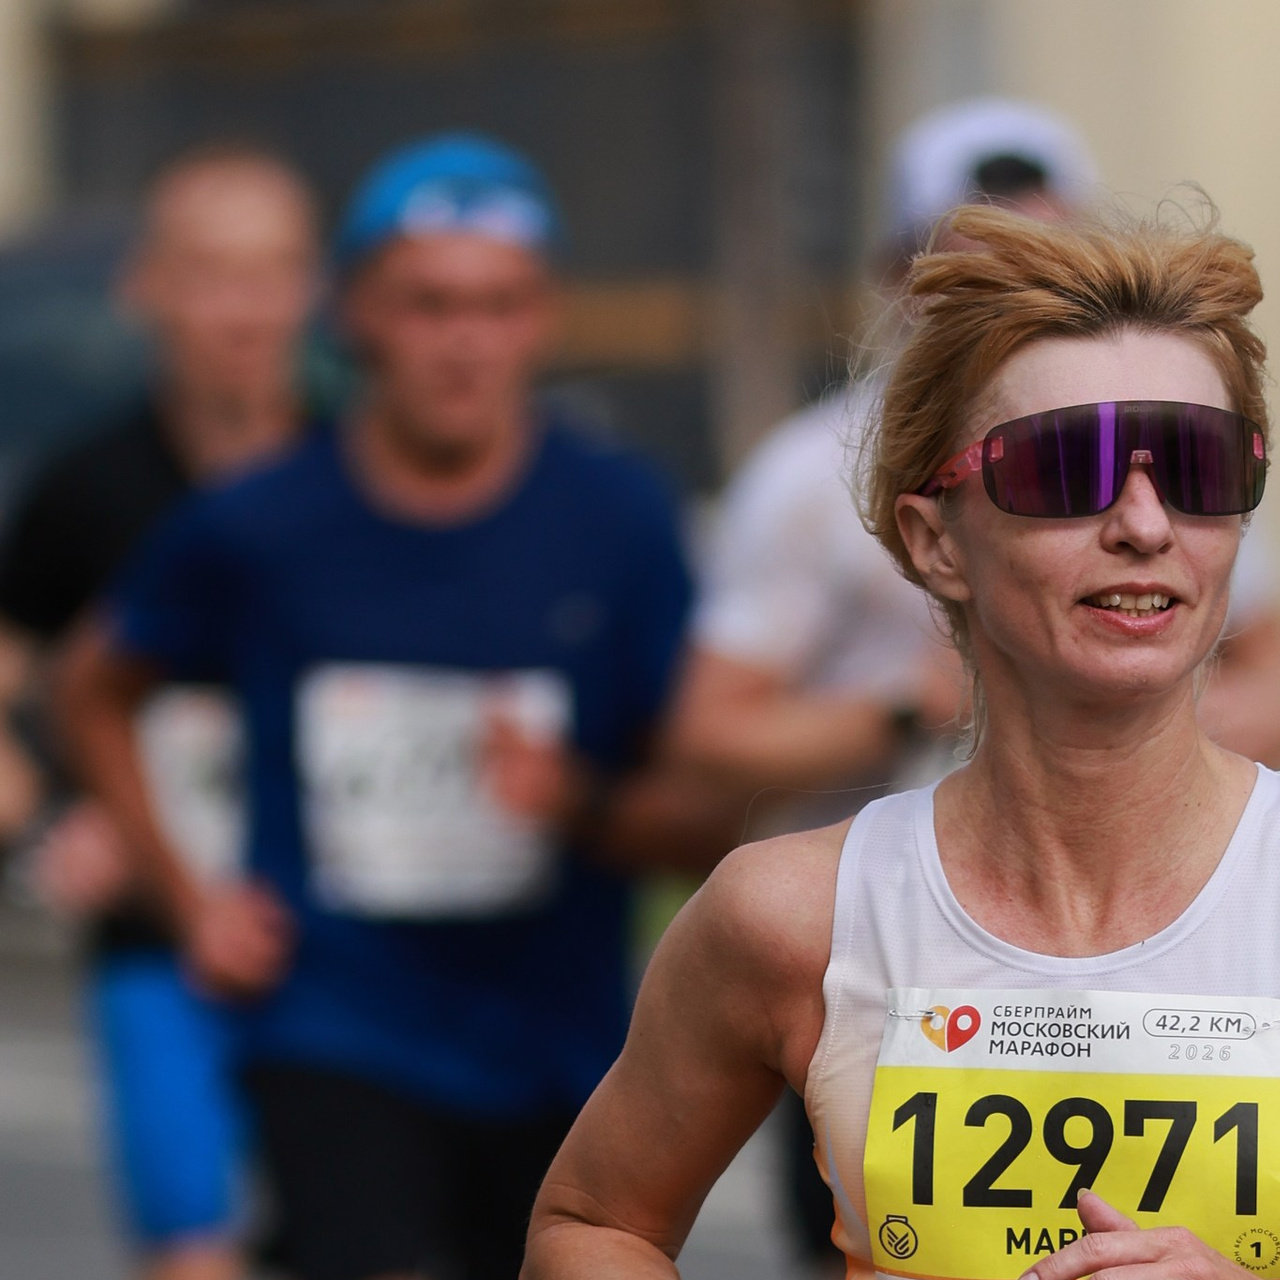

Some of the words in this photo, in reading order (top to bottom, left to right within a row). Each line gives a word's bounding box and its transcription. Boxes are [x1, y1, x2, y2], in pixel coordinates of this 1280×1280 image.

[993, 1005, 1092, 1019] СБЕРПРАЙМ
[991, 1021, 1130, 1040] МОСКОВСКИЙ
[1155, 1015, 1201, 1033] 42,2
[989, 1040, 1091, 1058] МАРАФОН
[1168, 1044, 1231, 1061] 2026
[892, 1091, 1259, 1216] 12971
[1006, 1227, 1088, 1255] МАР
[1250, 1241, 1261, 1258] 1
